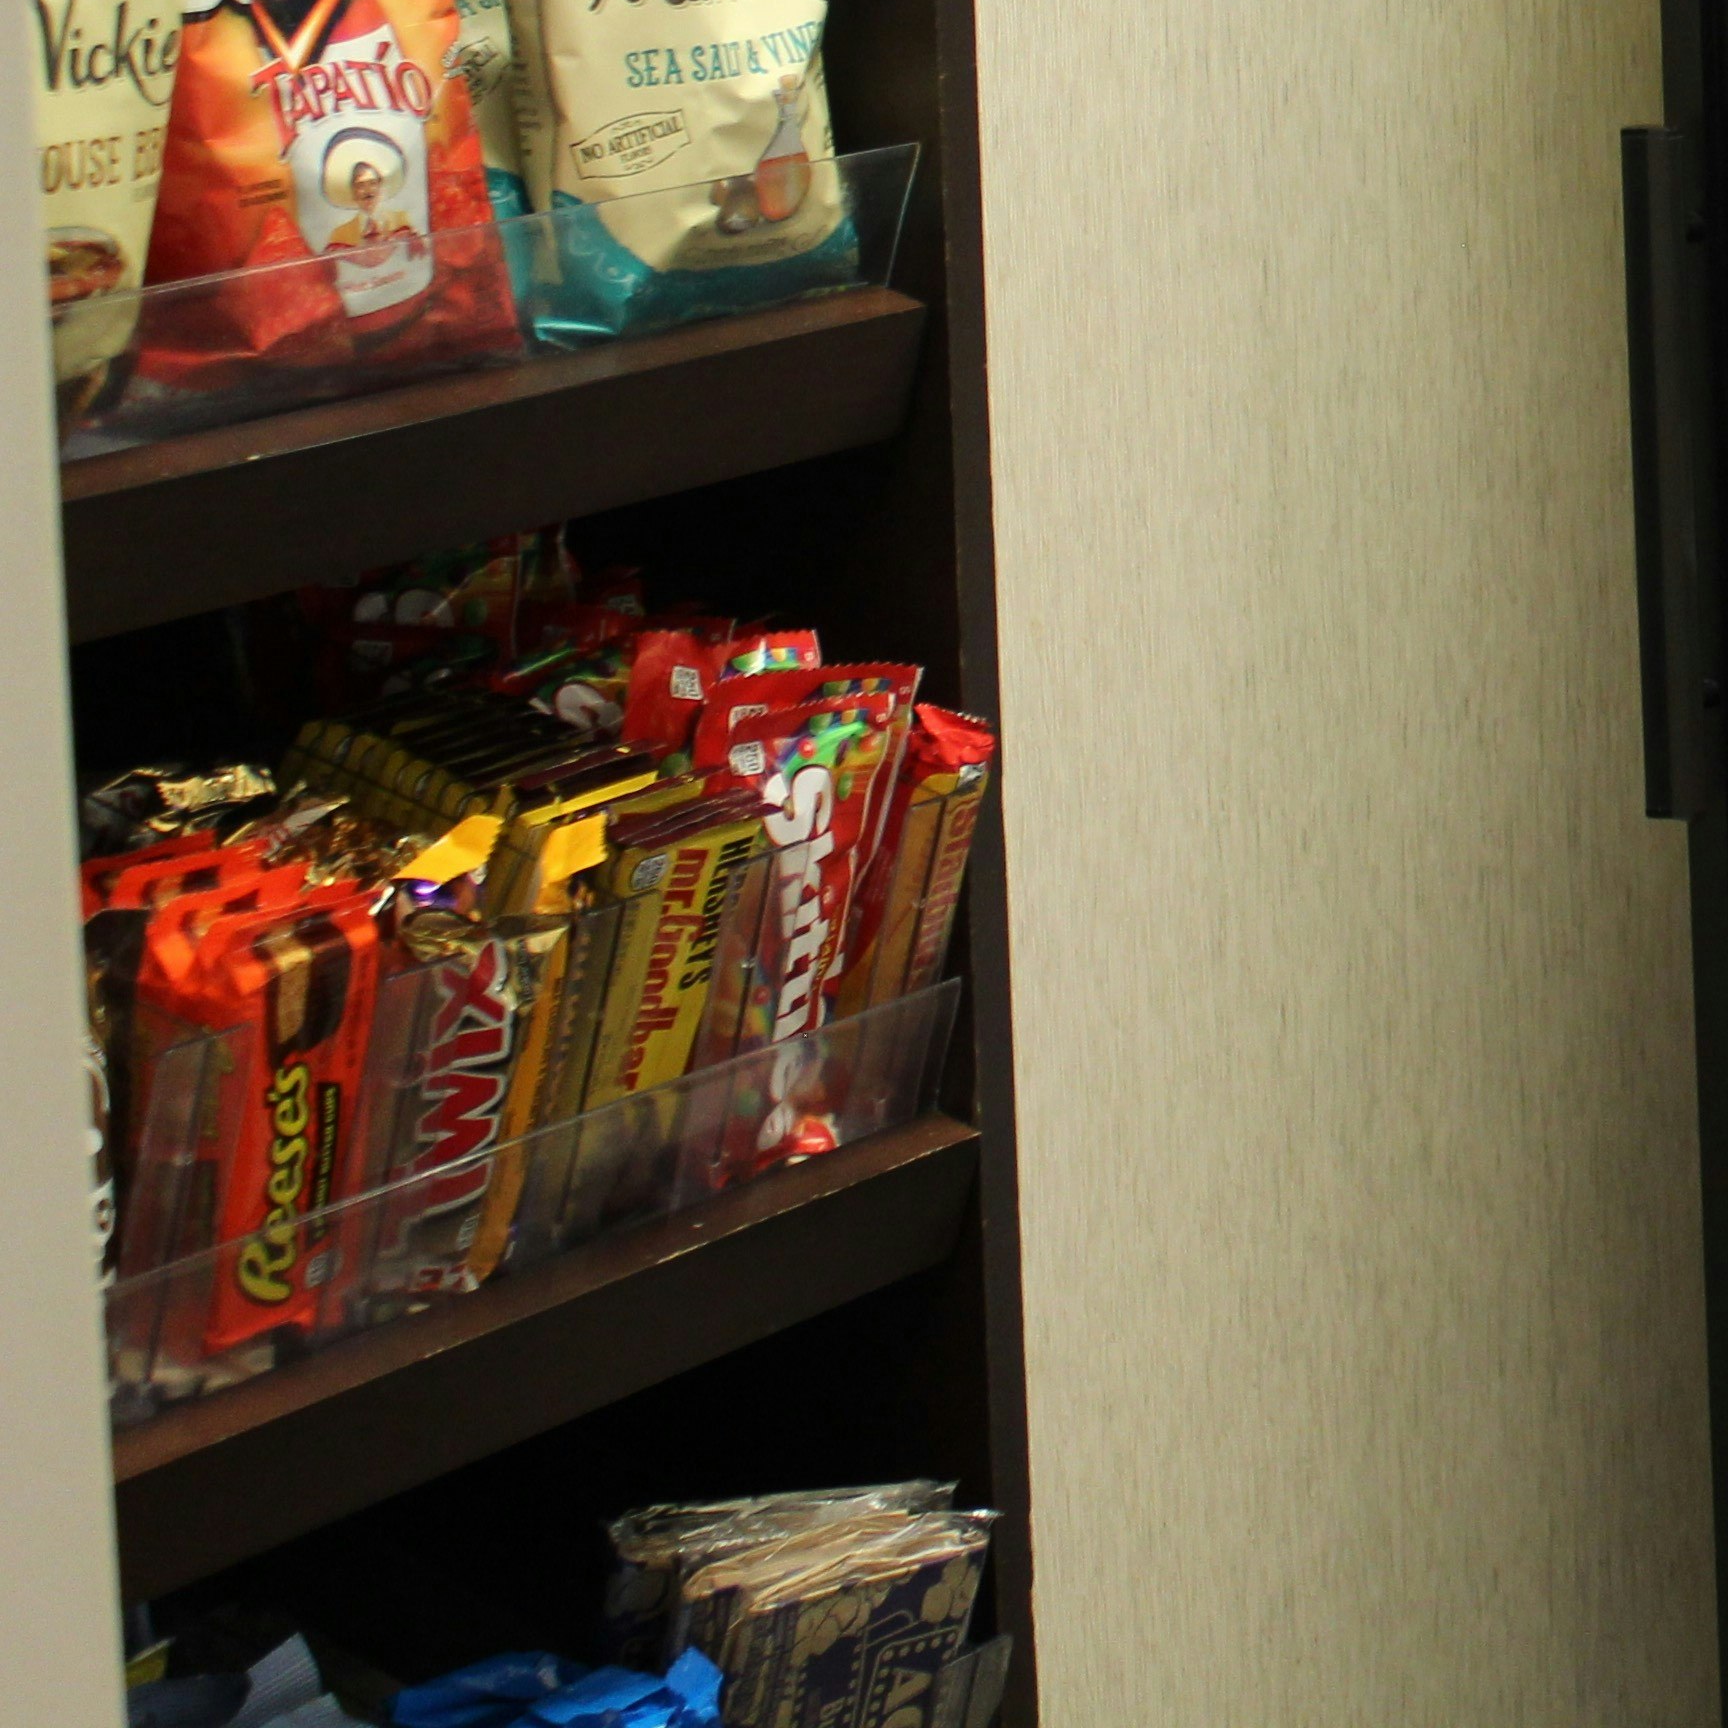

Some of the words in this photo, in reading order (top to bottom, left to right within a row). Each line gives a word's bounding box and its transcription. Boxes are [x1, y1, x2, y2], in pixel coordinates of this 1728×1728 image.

[626, 48, 684, 89] SEA
[691, 41, 741, 82] SALT
[748, 40, 767, 74] &
[581, 143, 604, 163] NO
[608, 117, 684, 155] ARTIFICIAL
[679, 836, 754, 990] HERSHEY'S
